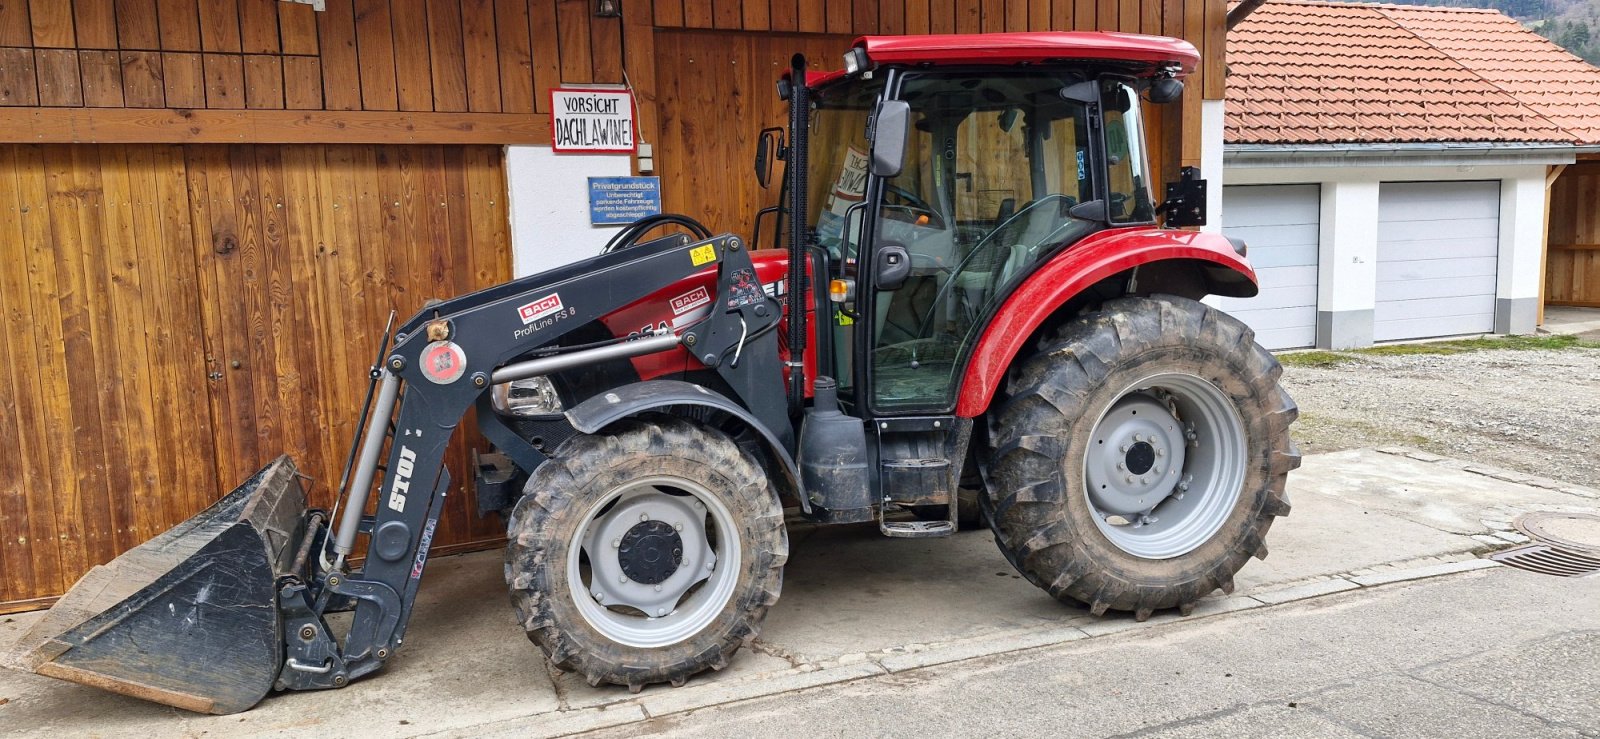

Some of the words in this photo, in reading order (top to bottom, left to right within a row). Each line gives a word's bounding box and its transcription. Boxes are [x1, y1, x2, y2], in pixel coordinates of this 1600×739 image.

[555, 117, 633, 147] DACHLAWINE!
[592, 182, 655, 191] Privatgrundstück
[615, 205, 657, 213] kostenpflichtig
[623, 198, 654, 206] Fahrzeuge
[523, 298, 557, 317] BACH
[675, 290, 704, 308] BACH
[513, 318, 553, 340] ProfiLine
[554, 310, 568, 322] FS
[569, 306, 576, 316] 8
